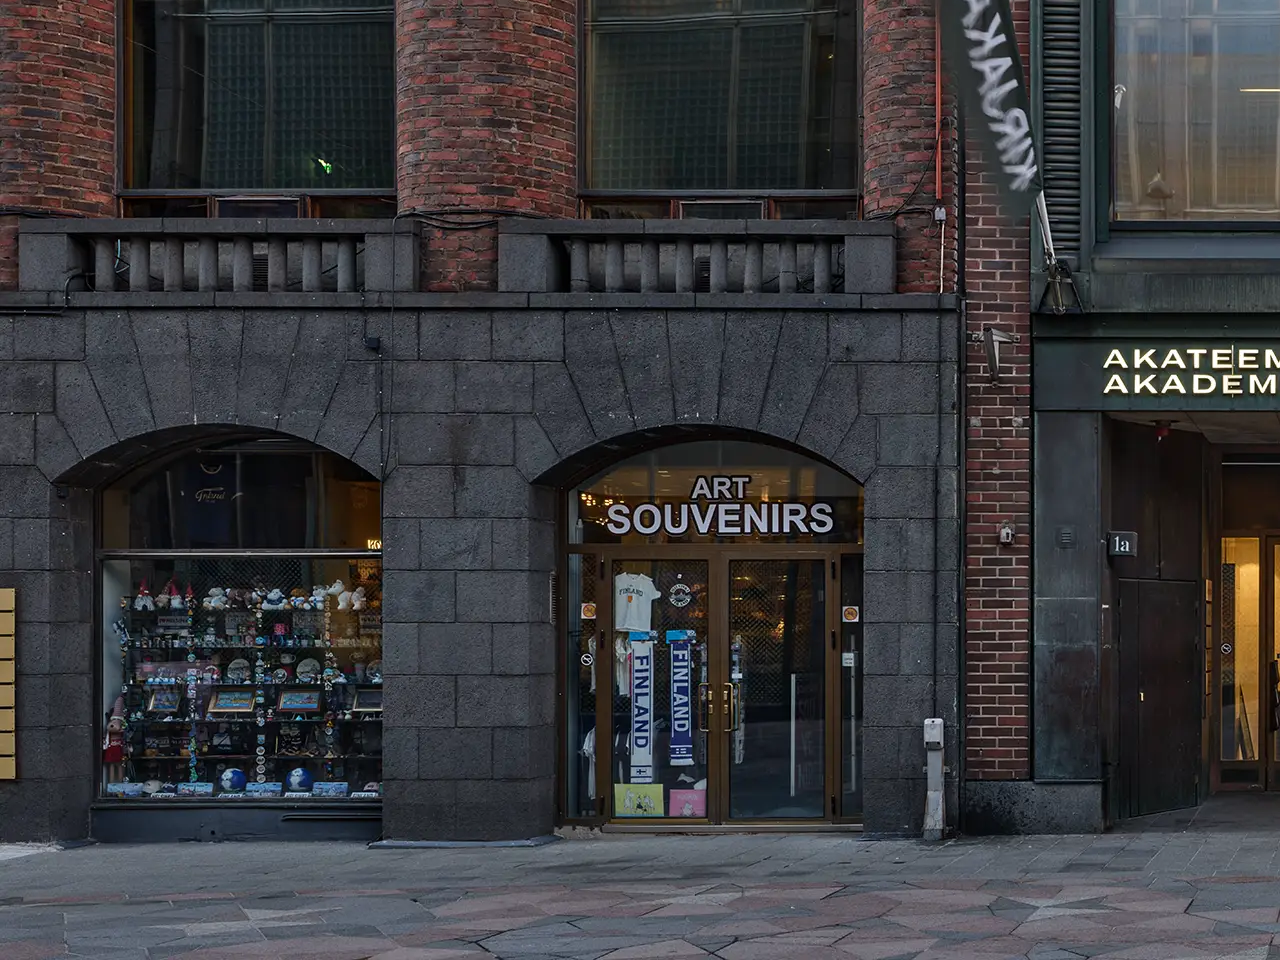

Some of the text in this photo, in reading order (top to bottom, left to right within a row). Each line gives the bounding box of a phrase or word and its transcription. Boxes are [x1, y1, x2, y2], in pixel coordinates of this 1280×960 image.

[691, 477, 749, 499] ART
[606, 503, 834, 534] SOUVENIRS
[1114, 535, 1130, 551] 1a
[619, 587, 644, 597] FINLAND
[634, 654, 650, 749] FINLAND
[673, 650, 689, 733] FINLAND
